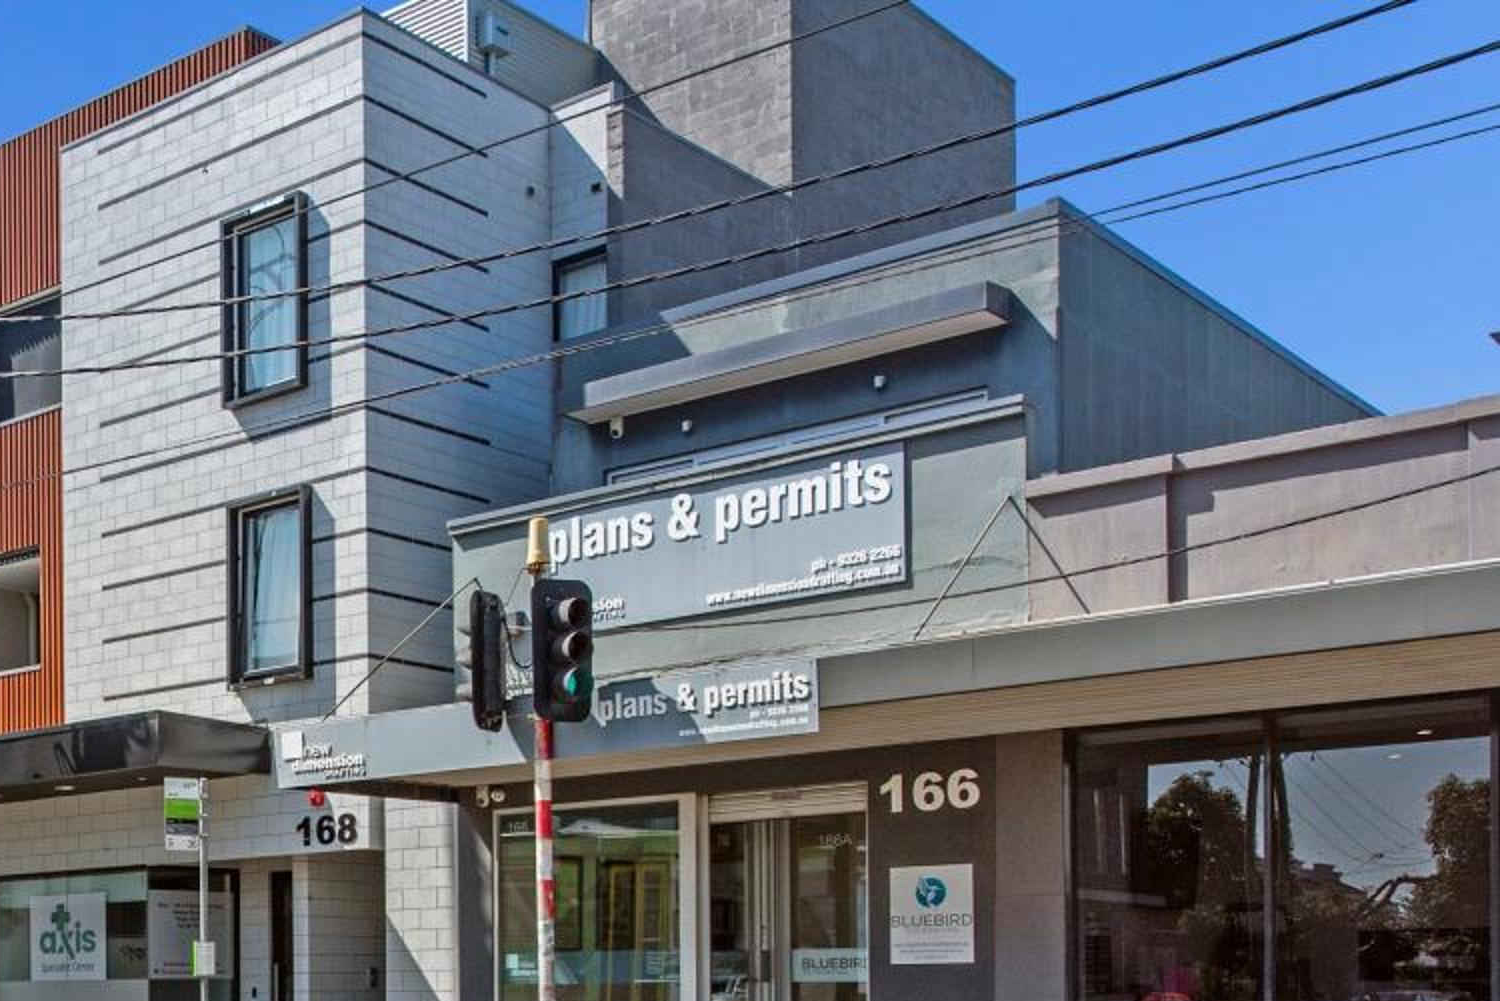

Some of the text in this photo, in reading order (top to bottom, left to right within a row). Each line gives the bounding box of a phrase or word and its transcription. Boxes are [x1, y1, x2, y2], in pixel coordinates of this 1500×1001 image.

[550, 459, 893, 575] plans & permits
[600, 692, 668, 727] plans
[676, 682, 698, 711] &
[704, 671, 810, 717] permits
[879, 768, 981, 813] 166
[296, 813, 358, 846] 168
[40, 921, 97, 960] axis
[891, 913, 972, 928] BLUEBIRD
